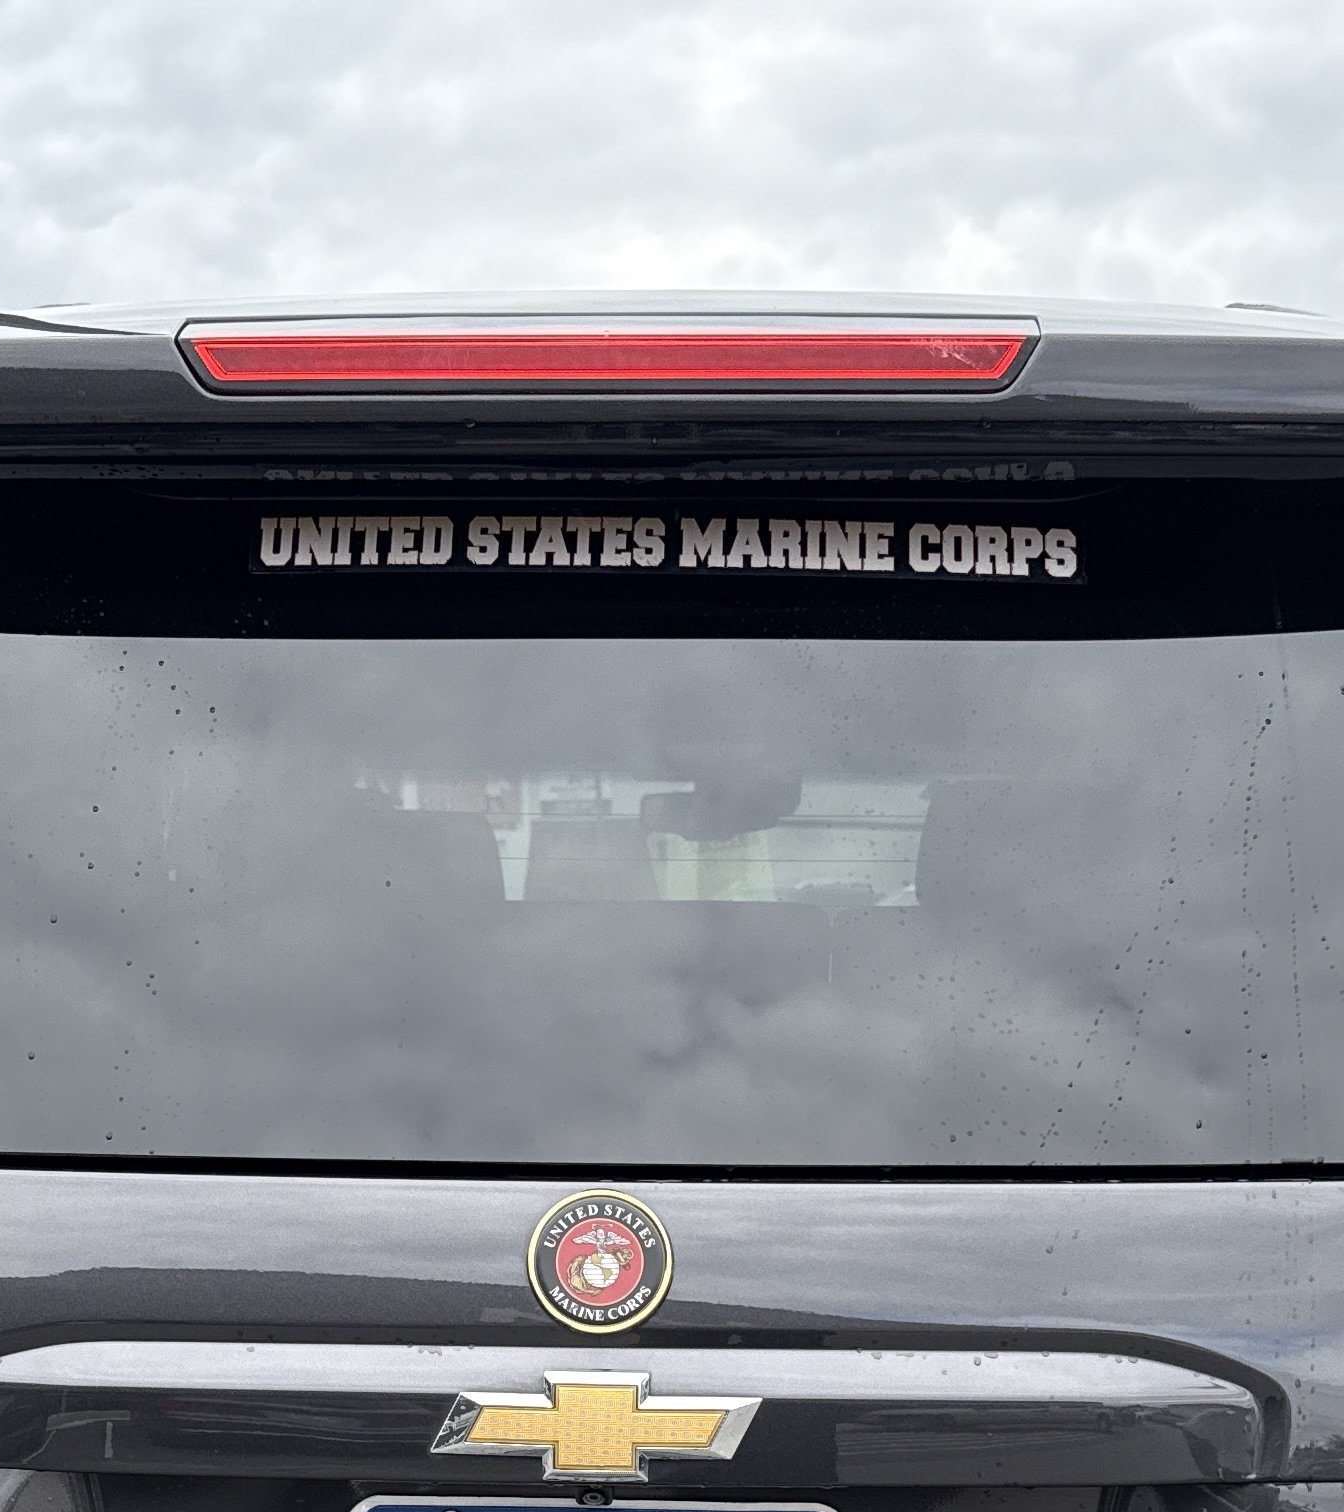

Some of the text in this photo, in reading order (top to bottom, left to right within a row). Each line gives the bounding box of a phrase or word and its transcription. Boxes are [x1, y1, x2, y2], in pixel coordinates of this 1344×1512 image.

[259, 515, 1079, 578] UNITED STATES MARINE CORPS
[543, 1204, 657, 1249] UNITED STATES
[548, 1285, 652, 1322] MARINE CORPS
